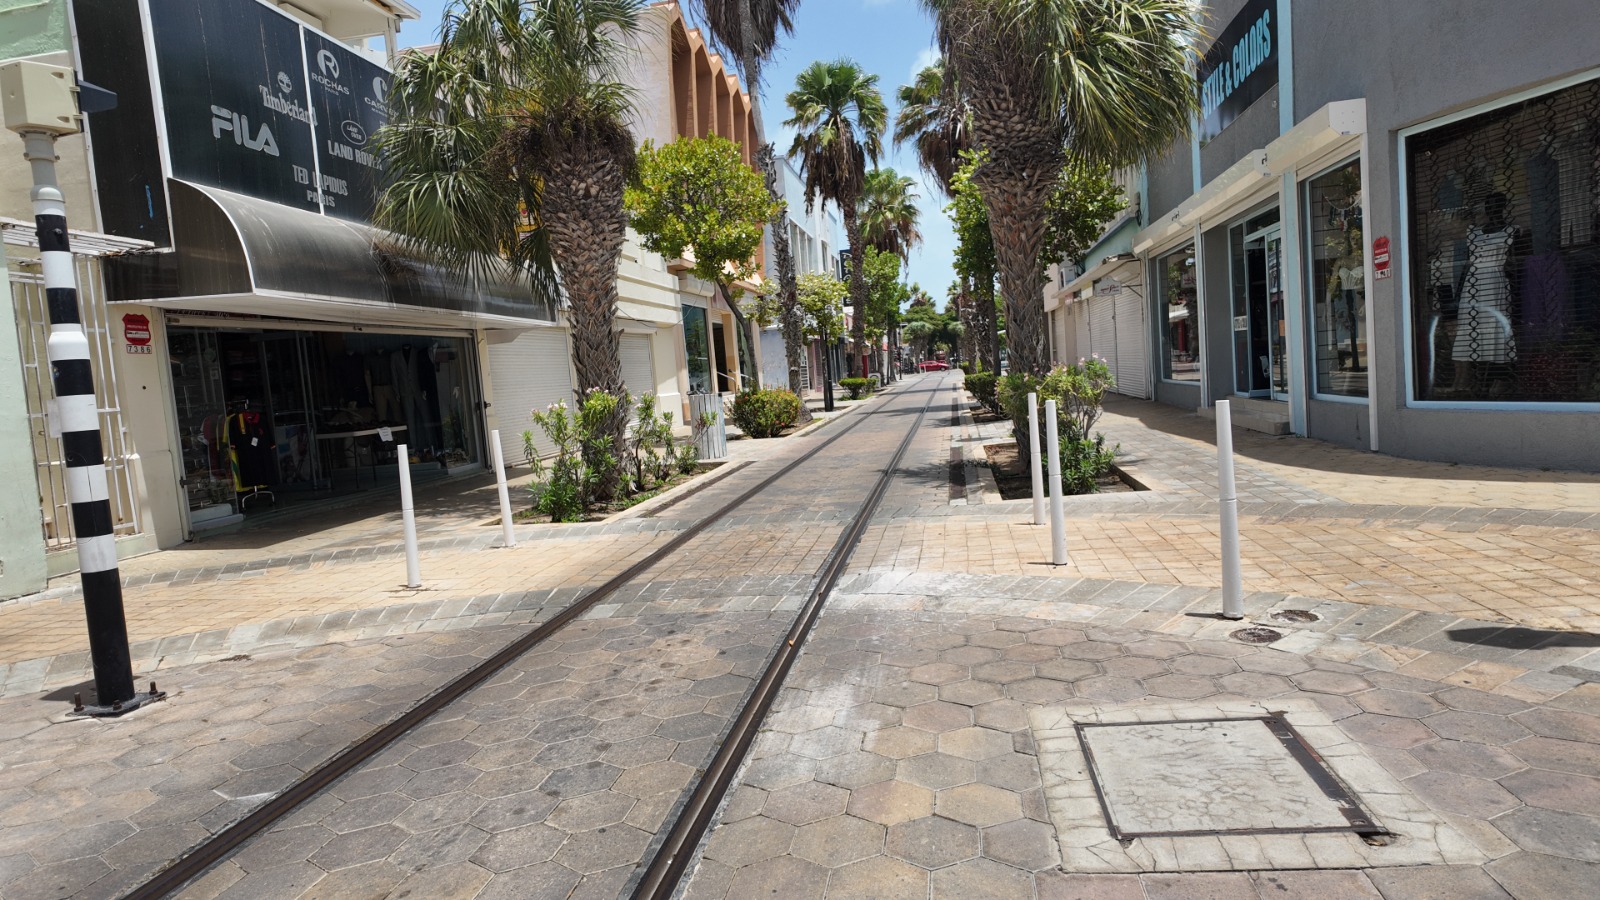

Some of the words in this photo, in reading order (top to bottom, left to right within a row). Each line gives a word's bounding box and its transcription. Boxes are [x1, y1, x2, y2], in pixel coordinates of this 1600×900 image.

[1202, 61, 1225, 120] STYLE
[1225, 61, 1233, 98] &
[1232, 8, 1271, 89] COLORS
[311, 72, 350, 95] ROCHAS
[259, 84, 319, 127] Timberland
[210, 104, 280, 157] FILA
[327, 139, 354, 161] LAND
[292, 164, 310, 185] TED
[312, 171, 349, 196] LAPIDUS
[128, 345, 151, 353] 7386
